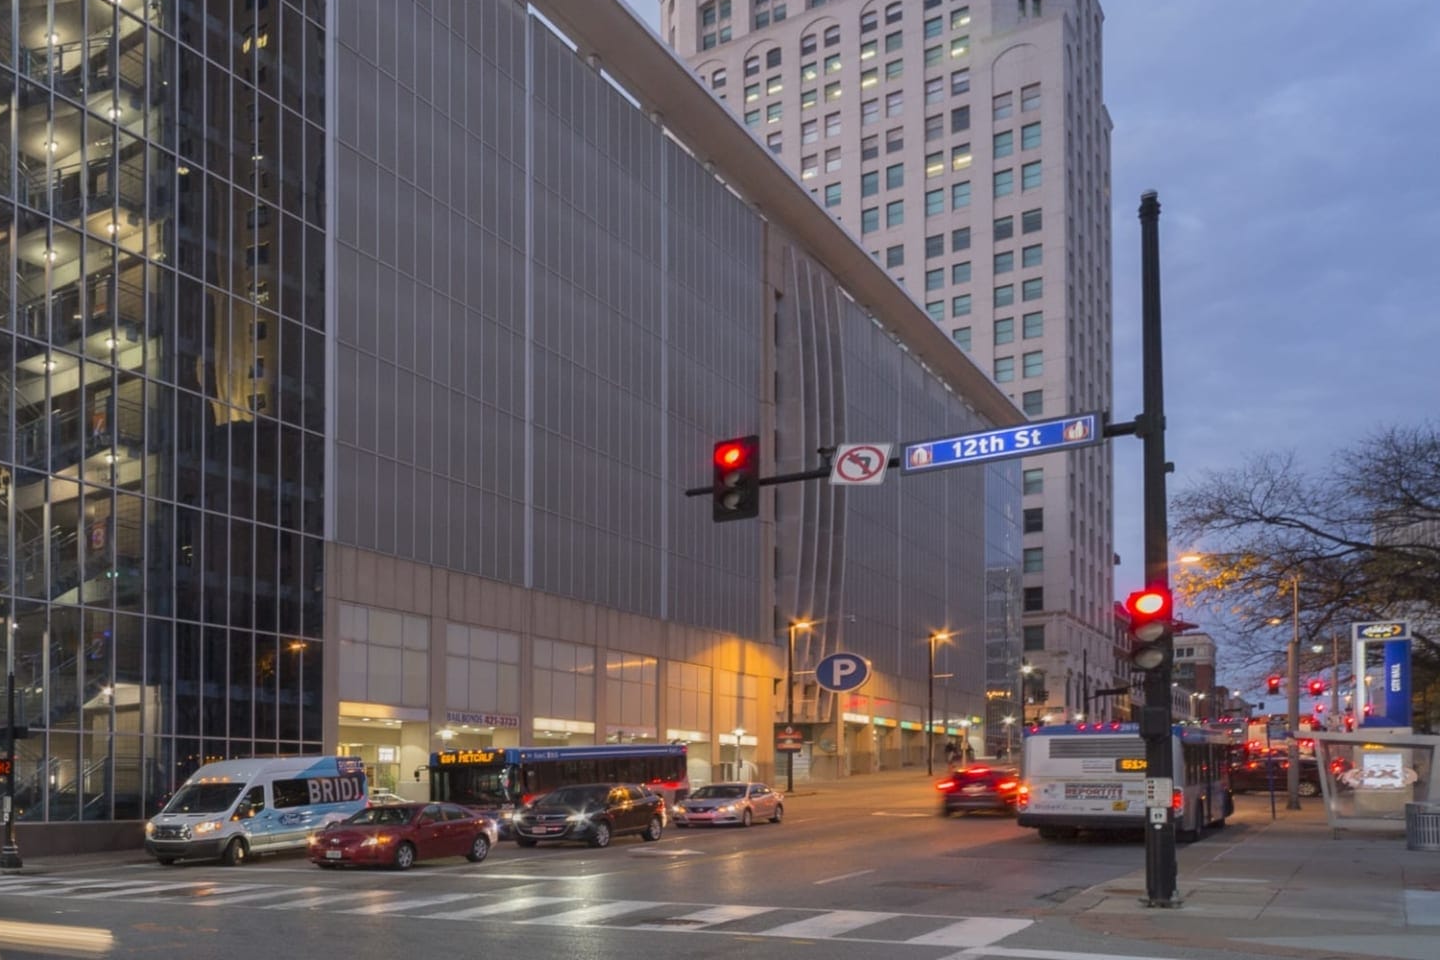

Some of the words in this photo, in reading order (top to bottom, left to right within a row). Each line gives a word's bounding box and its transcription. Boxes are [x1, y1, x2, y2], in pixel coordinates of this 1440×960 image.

[952, 435, 1005, 458] 12th
[1014, 429, 1041, 448] St
[832, 658, 857, 686] P
